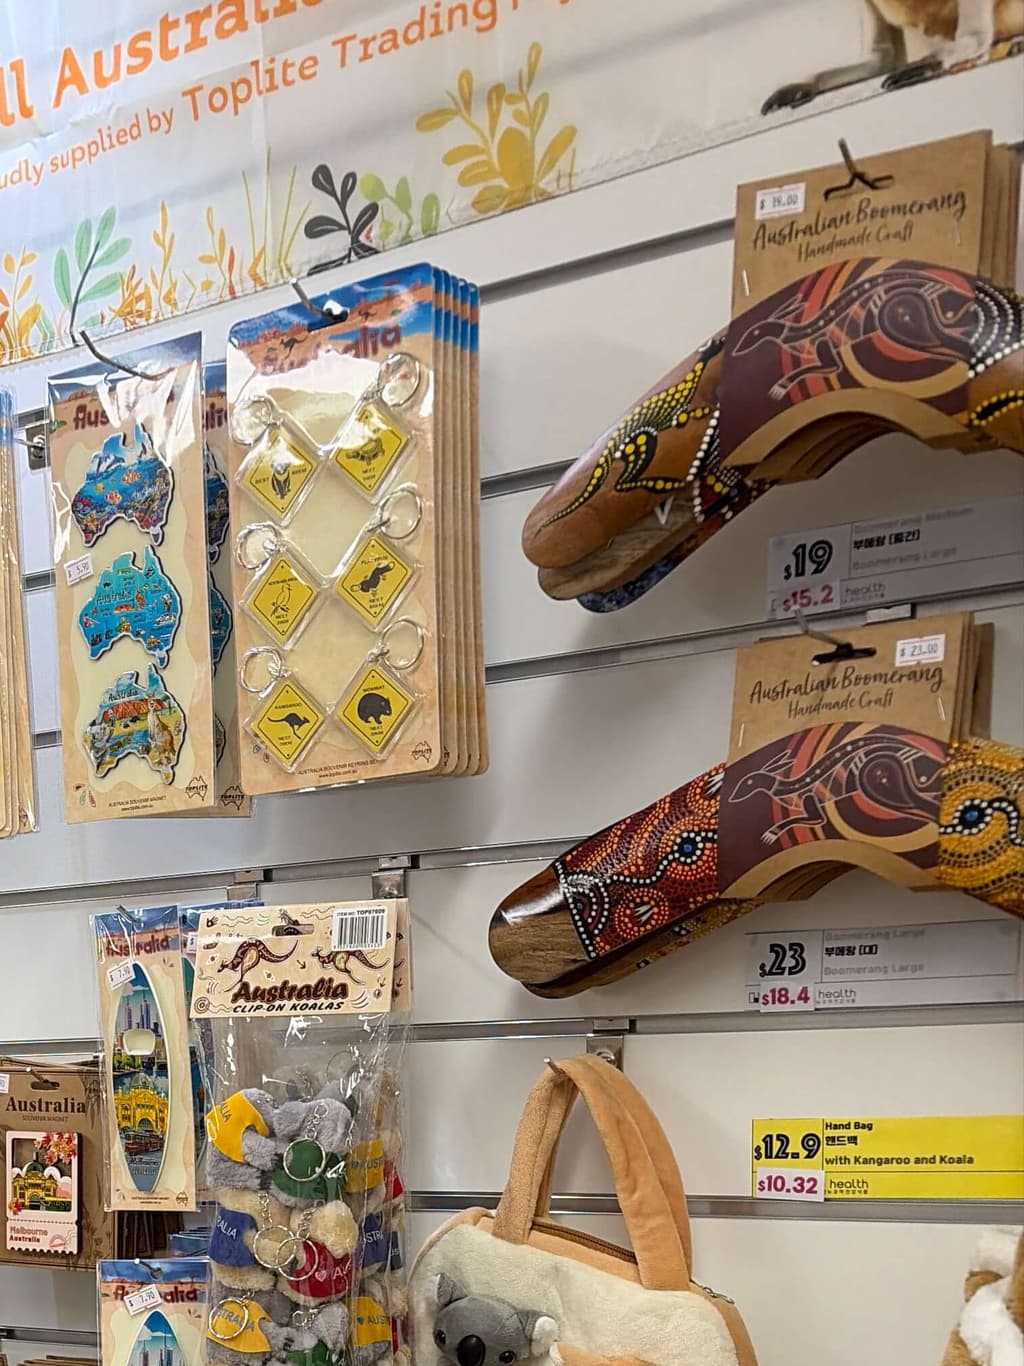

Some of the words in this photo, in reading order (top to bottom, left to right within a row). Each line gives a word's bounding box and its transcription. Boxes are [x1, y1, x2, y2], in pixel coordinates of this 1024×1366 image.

[52, 0, 322, 109] Austra
[49, 118, 141, 174] supplied
[147, 107, 175, 135] by
[182, 56, 317, 122] Toplite
[332, 0, 497, 69] Trading
[753, 209, 850, 250] Australian
[855, 190, 967, 223] Boomerang
[798, 227, 871, 262] Handmade
[877, 220, 913, 242] Craft
[784, 540, 833, 580] $19
[750, 672, 838, 704] Australian
[841, 666, 945, 693] Boomerang
[788, 697, 856, 719] Handmade
[859, 688, 893, 709] Craft
[759, 942, 806, 978] $23
[231, 978, 349, 1005] Australia
[761, 986, 810, 1006] $18.4
[818, 988, 856, 999] health
[233, 1003, 284, 1013] CLIP-ON
[289, 1001, 344, 1012] KOALAS
[5, 1097, 86, 1114] Australia
[825, 1121, 851, 1131] Hand
[854, 1121, 873, 1132] Bag
[754, 1132, 821, 1161] $12.9
[825, 1155, 851, 1165] with
[854, 1155, 911, 1168] Kangaroo
[914, 1154, 935, 1165] and
[939, 1154, 974, 1165] Koala
[758, 1175, 818, 1194] $10.32
[830, 1178, 869, 1189] health
[9, 1225, 48, 1236] Melbourne
[9, 1235, 41, 1243] Australia
[216, 1214, 237, 1240] RALIA
